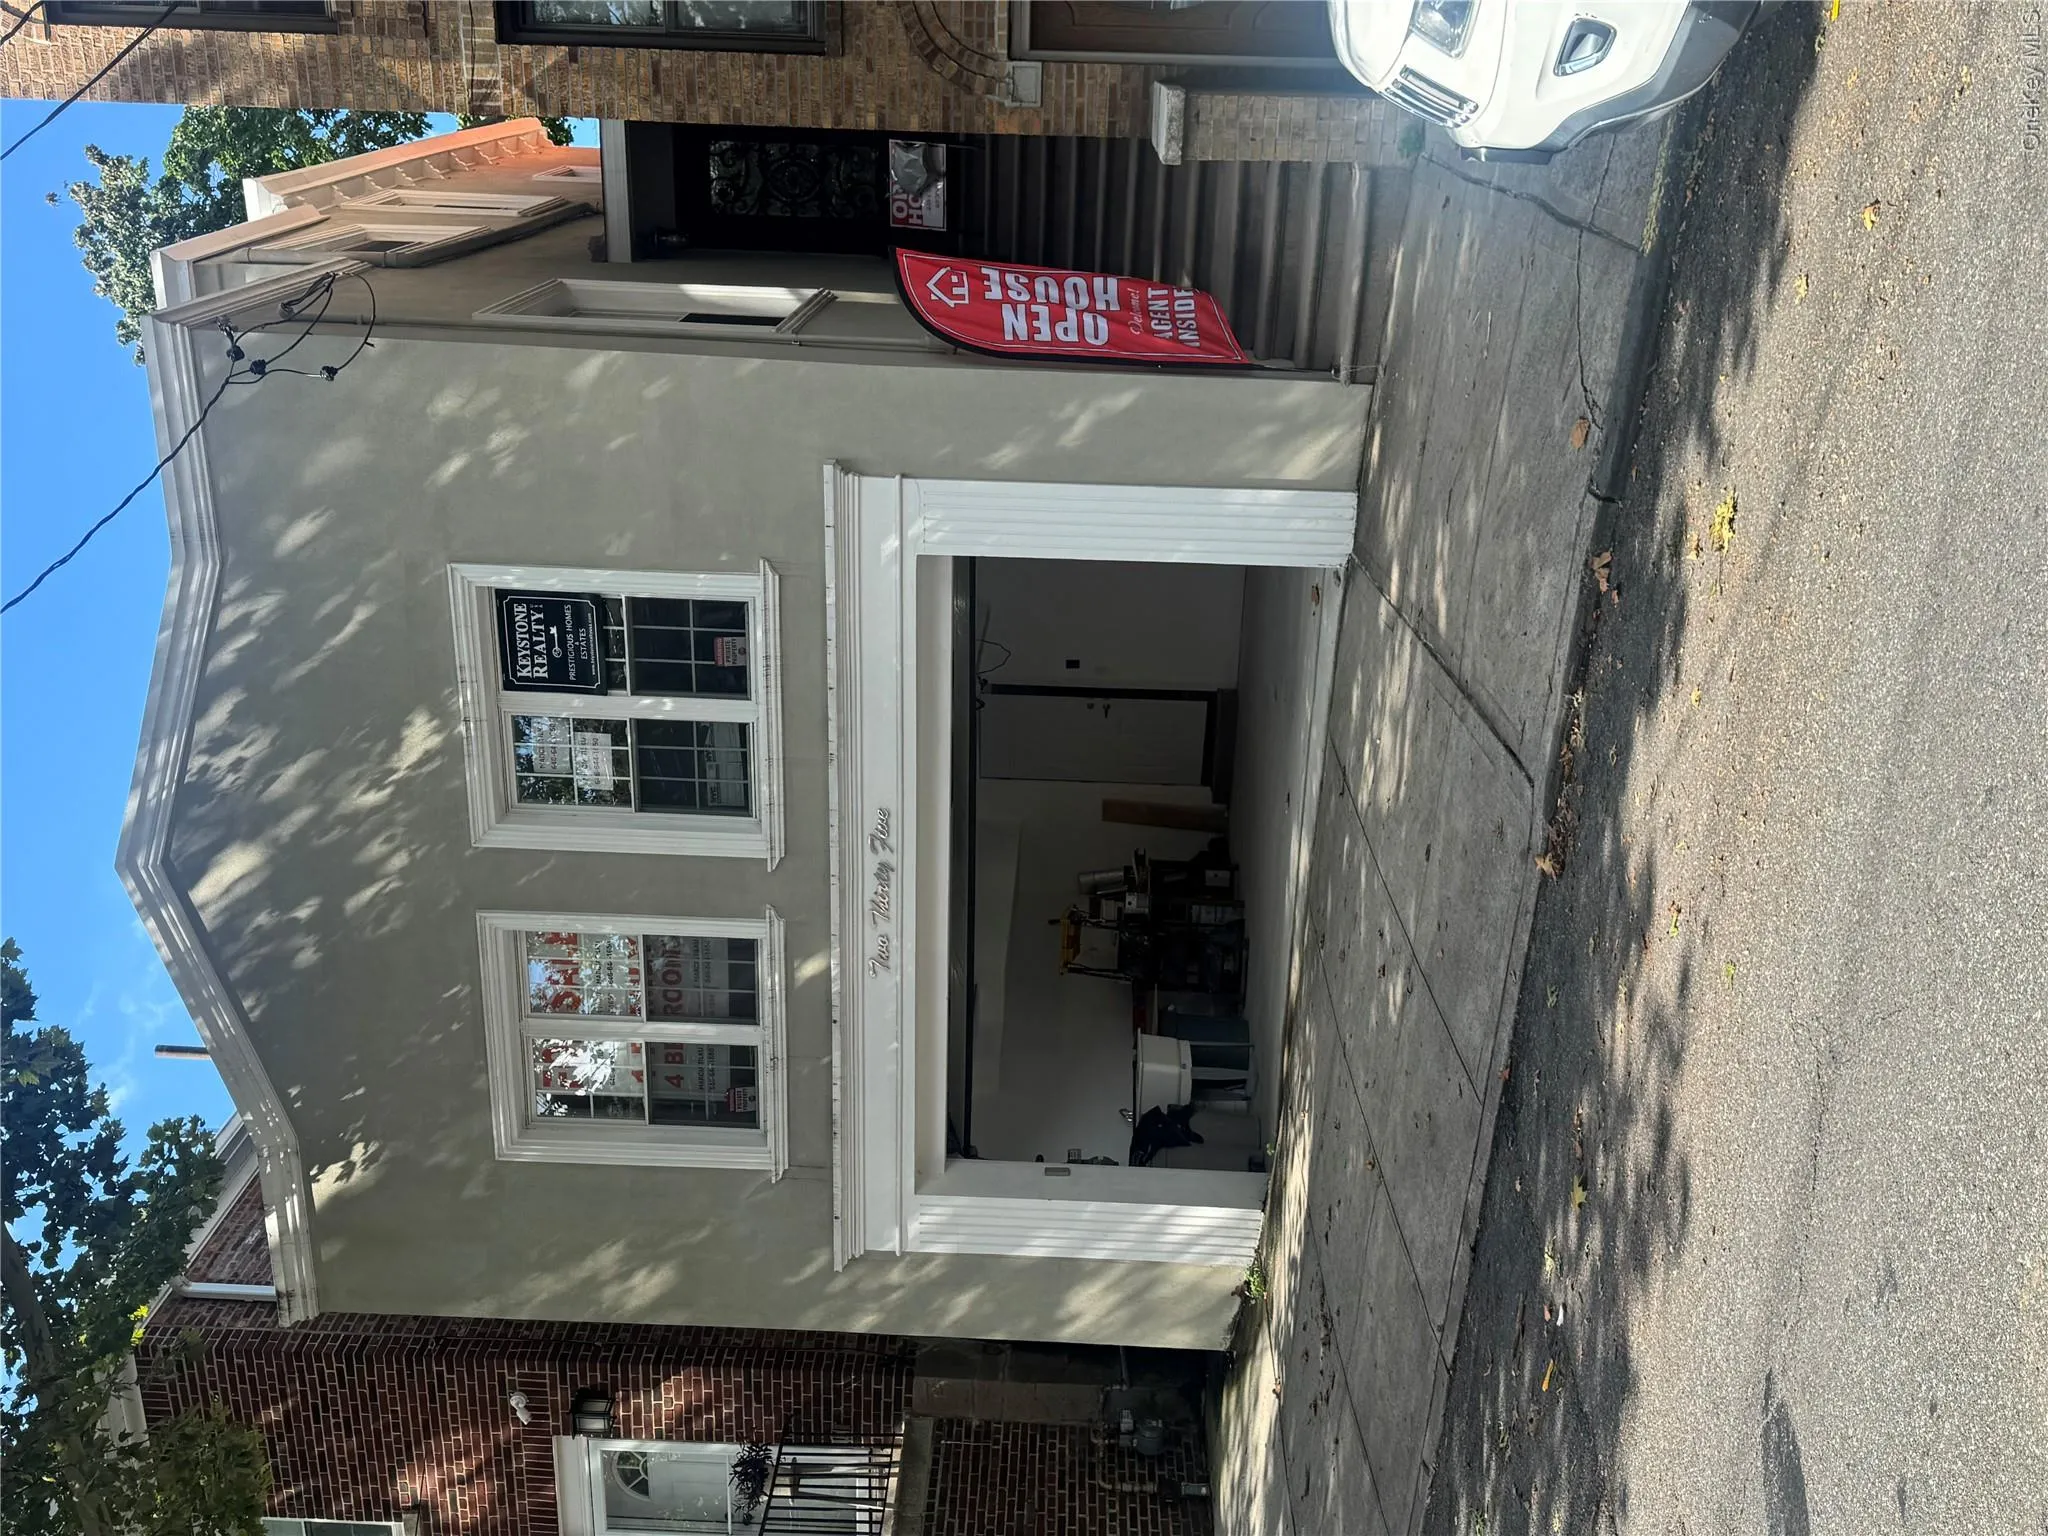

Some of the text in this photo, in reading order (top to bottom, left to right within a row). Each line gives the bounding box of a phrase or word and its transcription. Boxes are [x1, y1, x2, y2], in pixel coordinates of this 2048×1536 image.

[981, 266, 1122, 312] HOUSE
[1148, 287, 1174, 340] AGENT
[1001, 303, 1109, 346] OPEN
[514, 602, 532, 678] KEYSTONE
[530, 610, 548, 678] REALTY
[564, 604, 576, 680] PRESTIGIOUS HOMES
[579, 628, 588, 660] ESTATES
[868, 808, 895, 978] Two Thirty Five
[664, 1074, 684, 1088] 4
